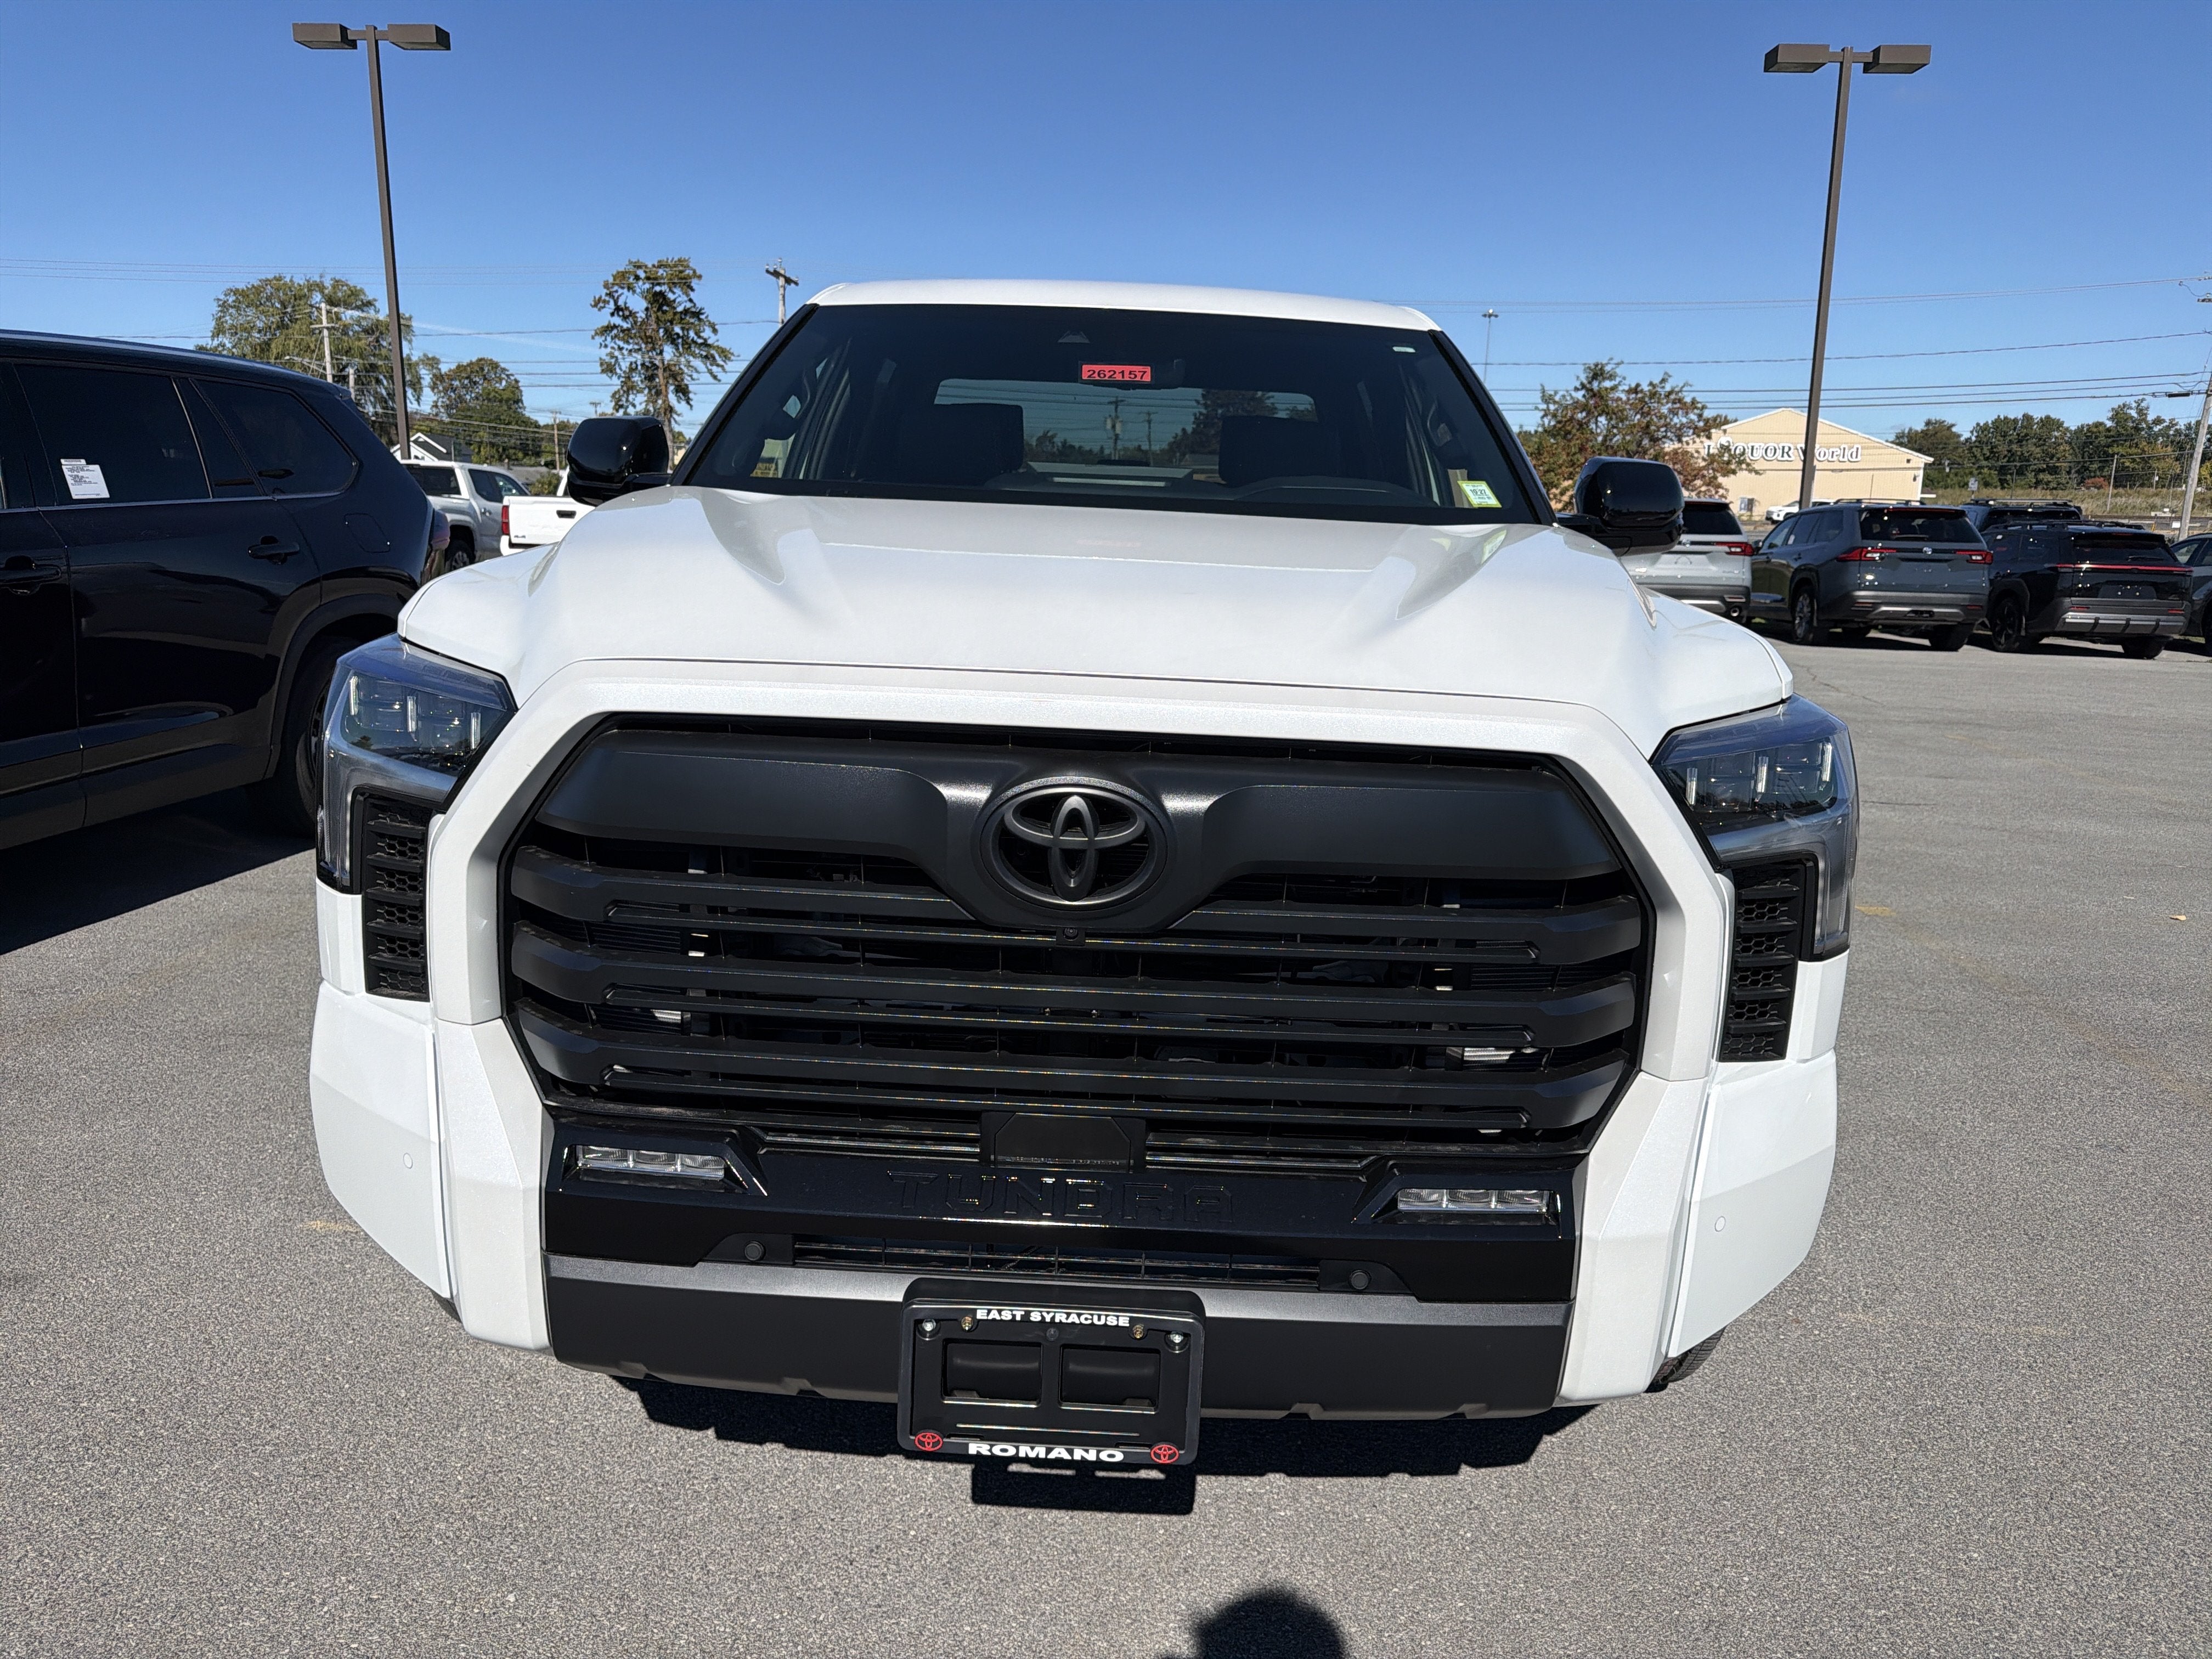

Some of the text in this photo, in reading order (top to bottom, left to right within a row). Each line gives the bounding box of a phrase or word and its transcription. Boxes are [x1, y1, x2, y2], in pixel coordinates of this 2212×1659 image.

[1086, 369, 1148, 380] 262157
[1703, 436, 1795, 460] LQUOR
[887, 1170, 1233, 1223] TUNDRA
[976, 1309, 1130, 1327] EAST SYRACUSE
[968, 1443, 1124, 1462] ROMANO
